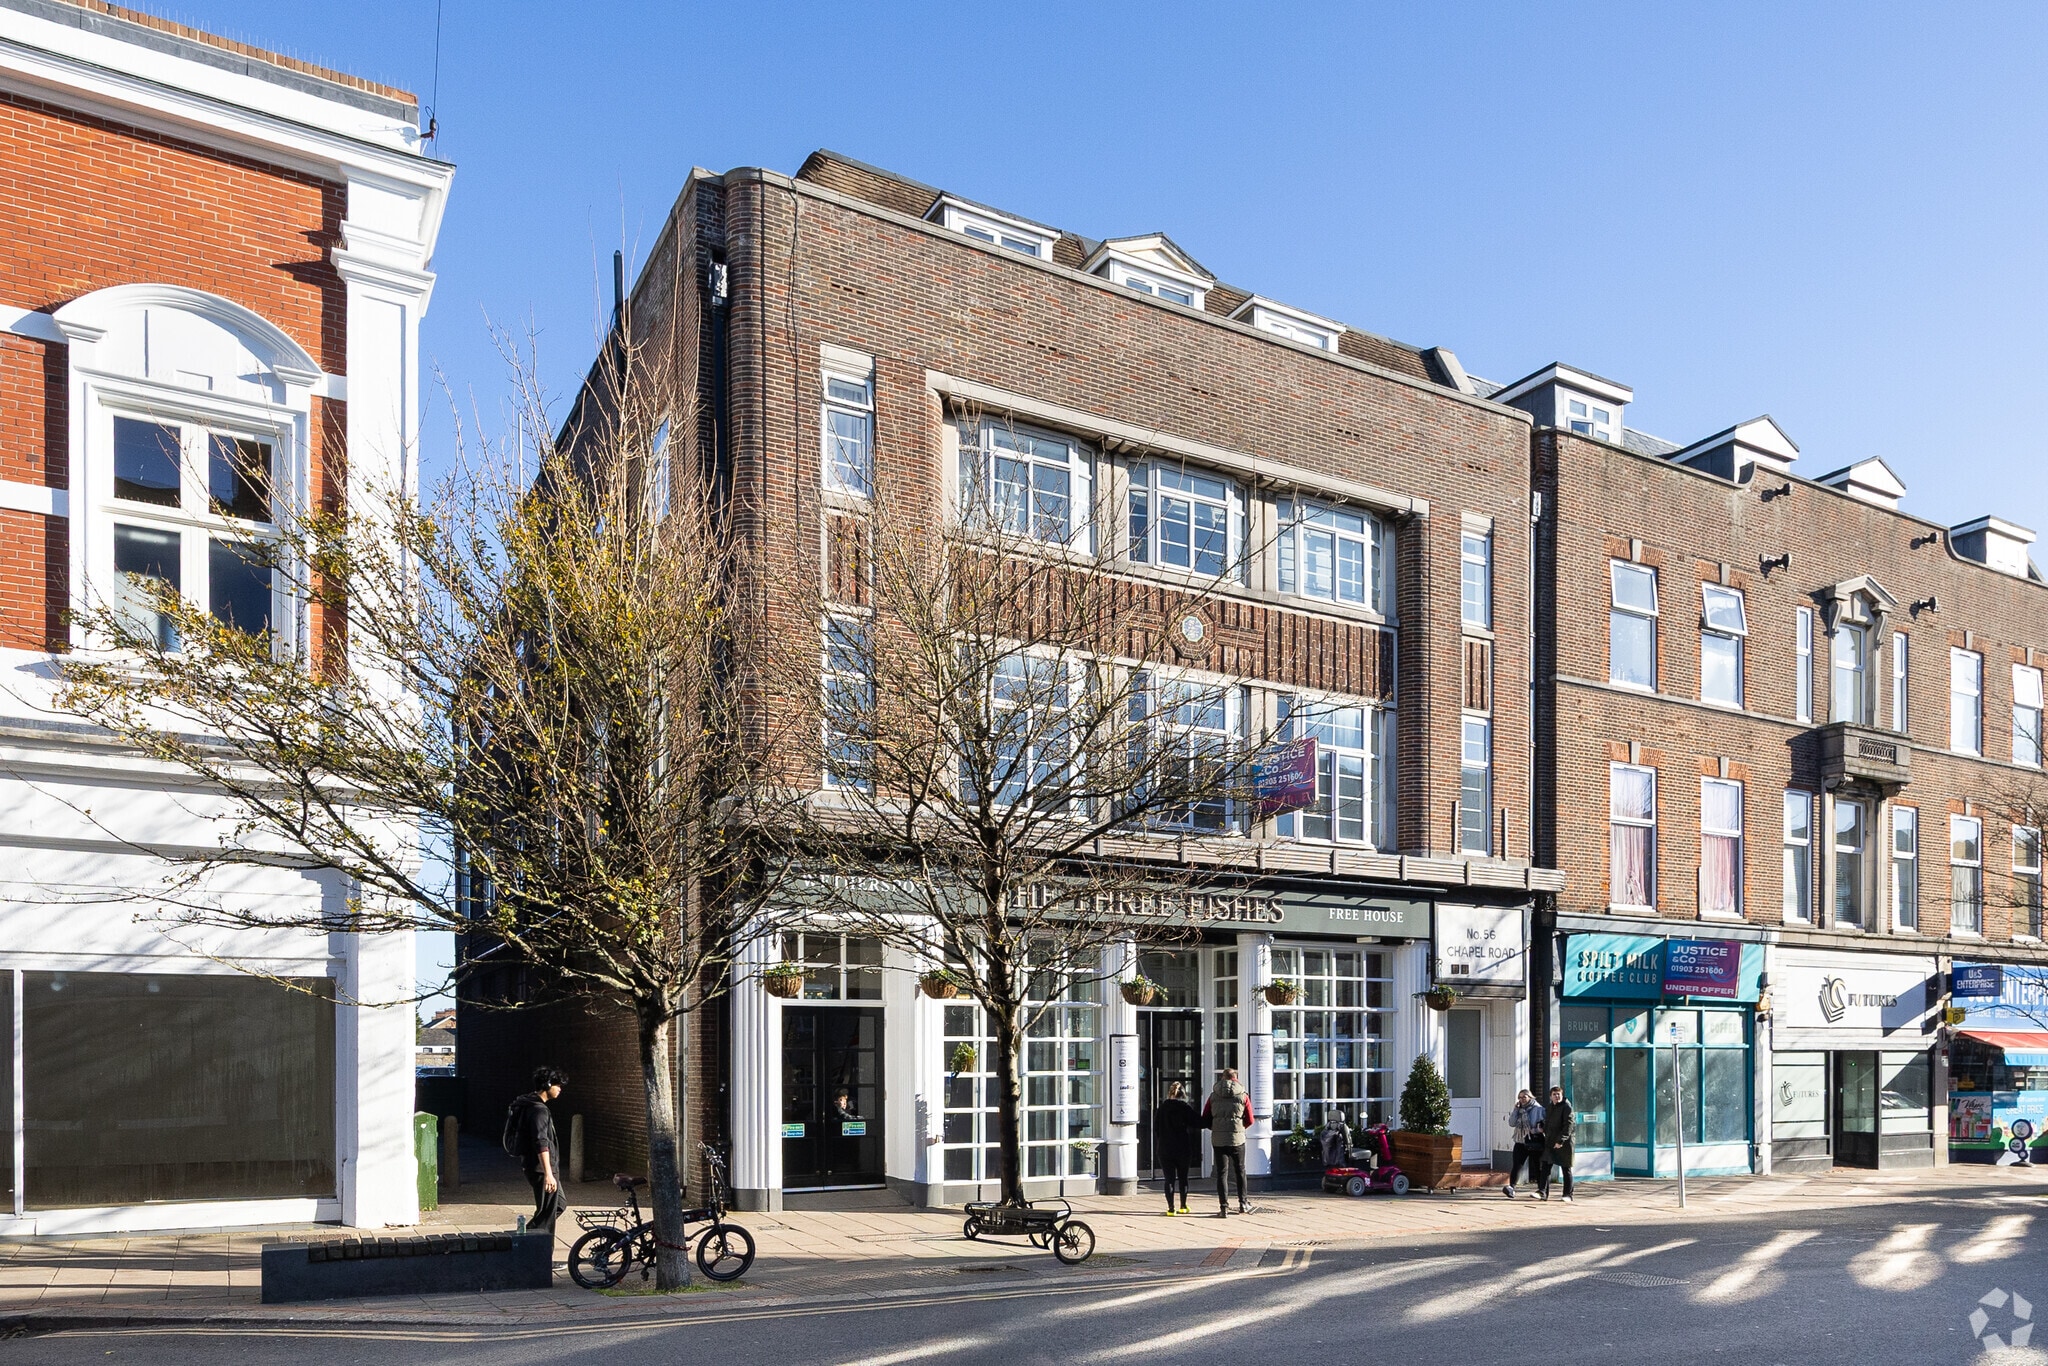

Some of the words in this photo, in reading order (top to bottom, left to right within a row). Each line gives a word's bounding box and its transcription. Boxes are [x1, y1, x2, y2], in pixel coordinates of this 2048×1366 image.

[1075, 888, 1173, 918] THREE
[1189, 892, 1286, 924] FISHES
[1329, 908, 1359, 920] FREE
[1364, 910, 1404, 923] HOUSE
[1466, 928, 1482, 940] No.
[1483, 929, 1496, 940] 56
[1447, 946, 1486, 958] CHAPEL
[1488, 947, 1516, 959] ROAD
[1673, 945, 1728, 957] JUSTICE
[1579, 950, 1621, 969] SPILT
[1626, 952, 1658, 970] MILK
[1671, 965, 1693, 973] 01903
[1695, 966, 1724, 975] 251600
[1579, 970, 1624, 983] COFFEE
[1629, 972, 1657, 983] CLUB
[1665, 984, 1699, 993] UNDER
[1701, 986, 1734, 995] OFFER
[1956, 979, 1995, 989] ENTERPRISE
[1848, 993, 1897, 1008] FUTURES
[1567, 1020, 1599, 1032] BRUNCH
[1710, 1021, 1738, 1034] COFFEE
[2026, 1104, 2045, 1114] PRICE
